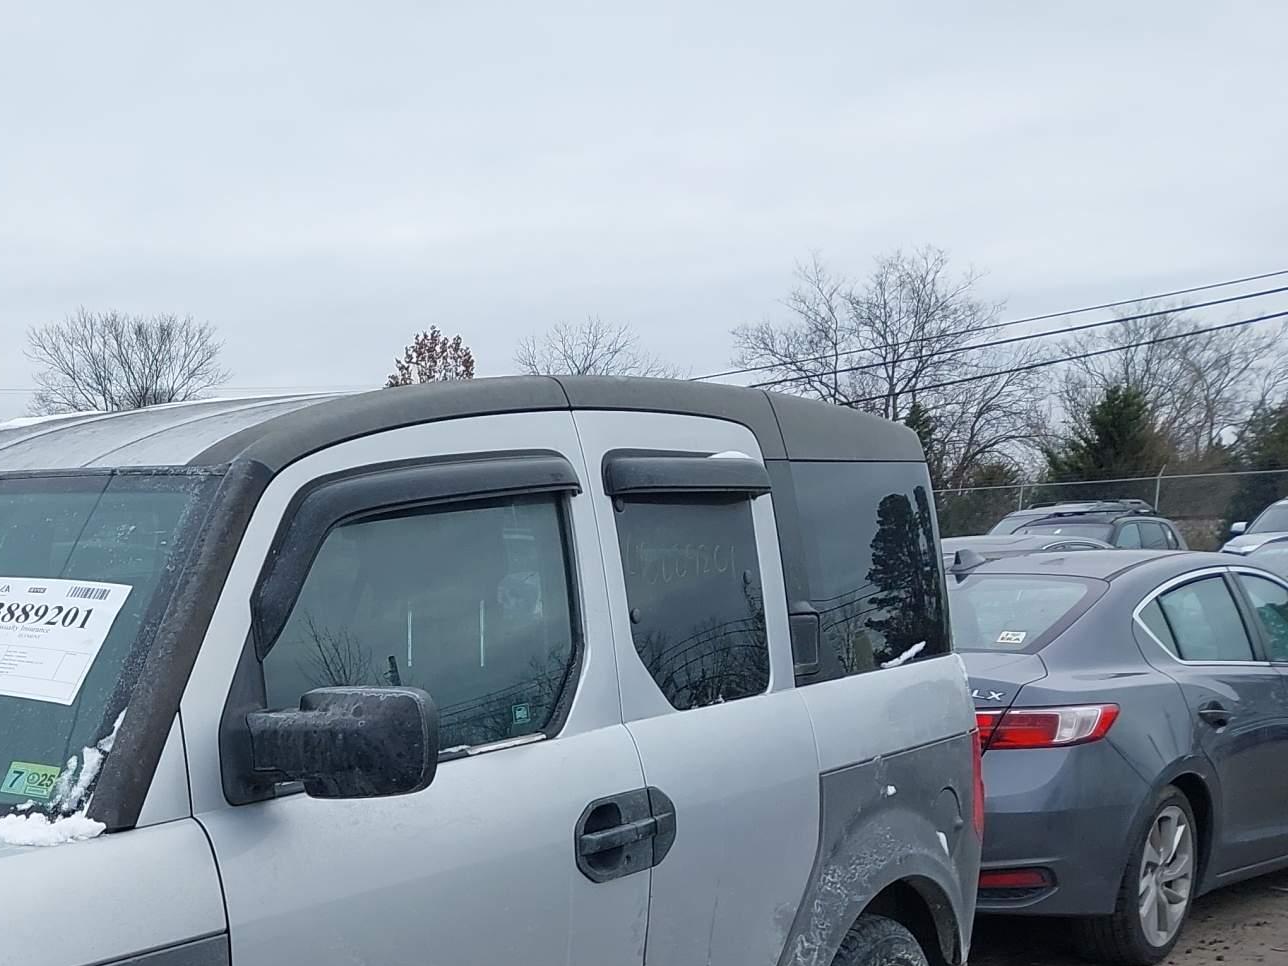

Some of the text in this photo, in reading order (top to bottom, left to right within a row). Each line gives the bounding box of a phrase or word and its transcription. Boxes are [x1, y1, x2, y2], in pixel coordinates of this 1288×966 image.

[20, 624, 51, 634] Insurance
[9, 770, 56, 787] 7 25
